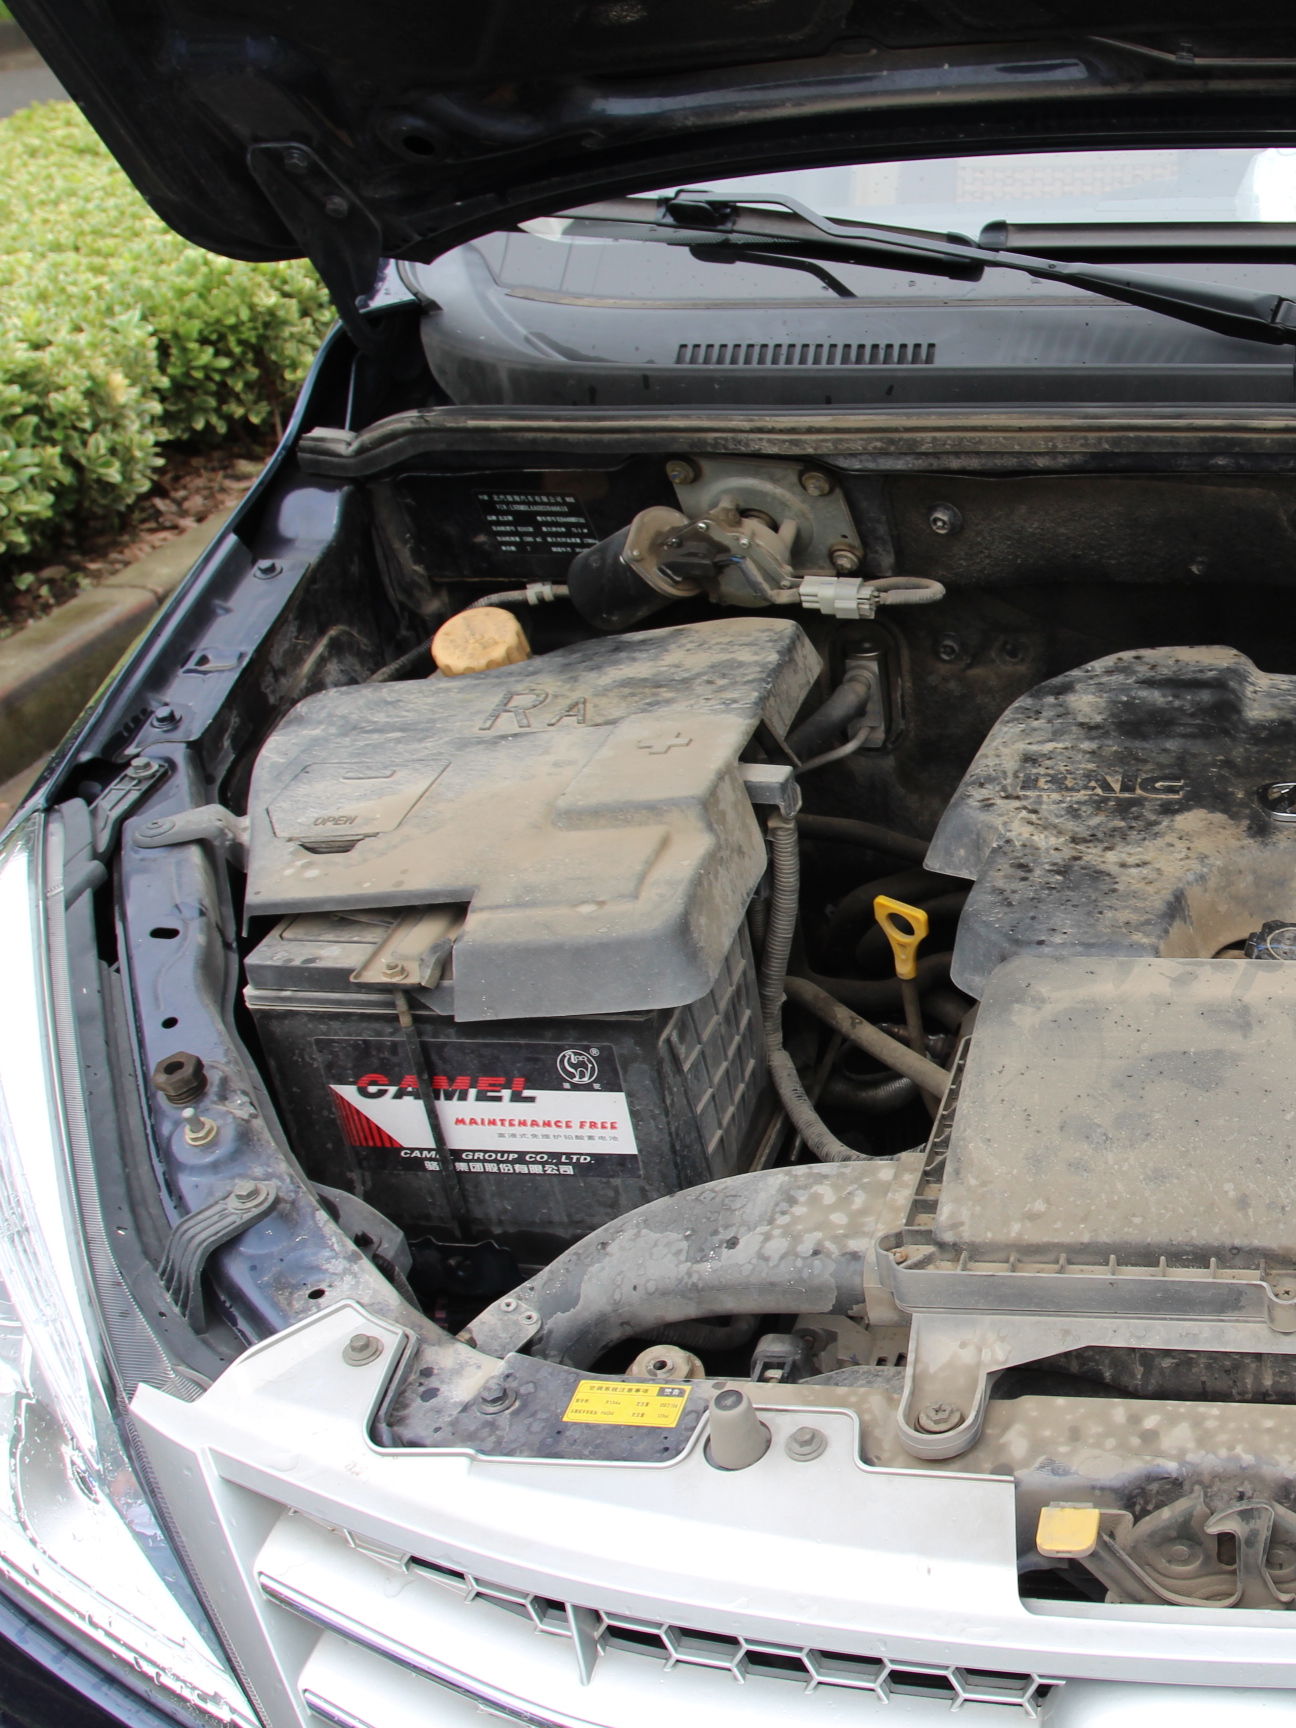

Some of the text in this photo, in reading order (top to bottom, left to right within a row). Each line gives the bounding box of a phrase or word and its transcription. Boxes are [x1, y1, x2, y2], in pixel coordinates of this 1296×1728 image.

[1019, 772, 1184, 798] BAIC
[313, 815, 358, 826] OPEN
[356, 1073, 537, 1103] CAMEL
[454, 1117, 618, 1130] MAINTENANCE FREE
[400, 1150, 454, 1160] CAM
[461, 1152, 518, 1161] GROUP
[423, 1161, 574, 1175] 骆集团股份有限公司
